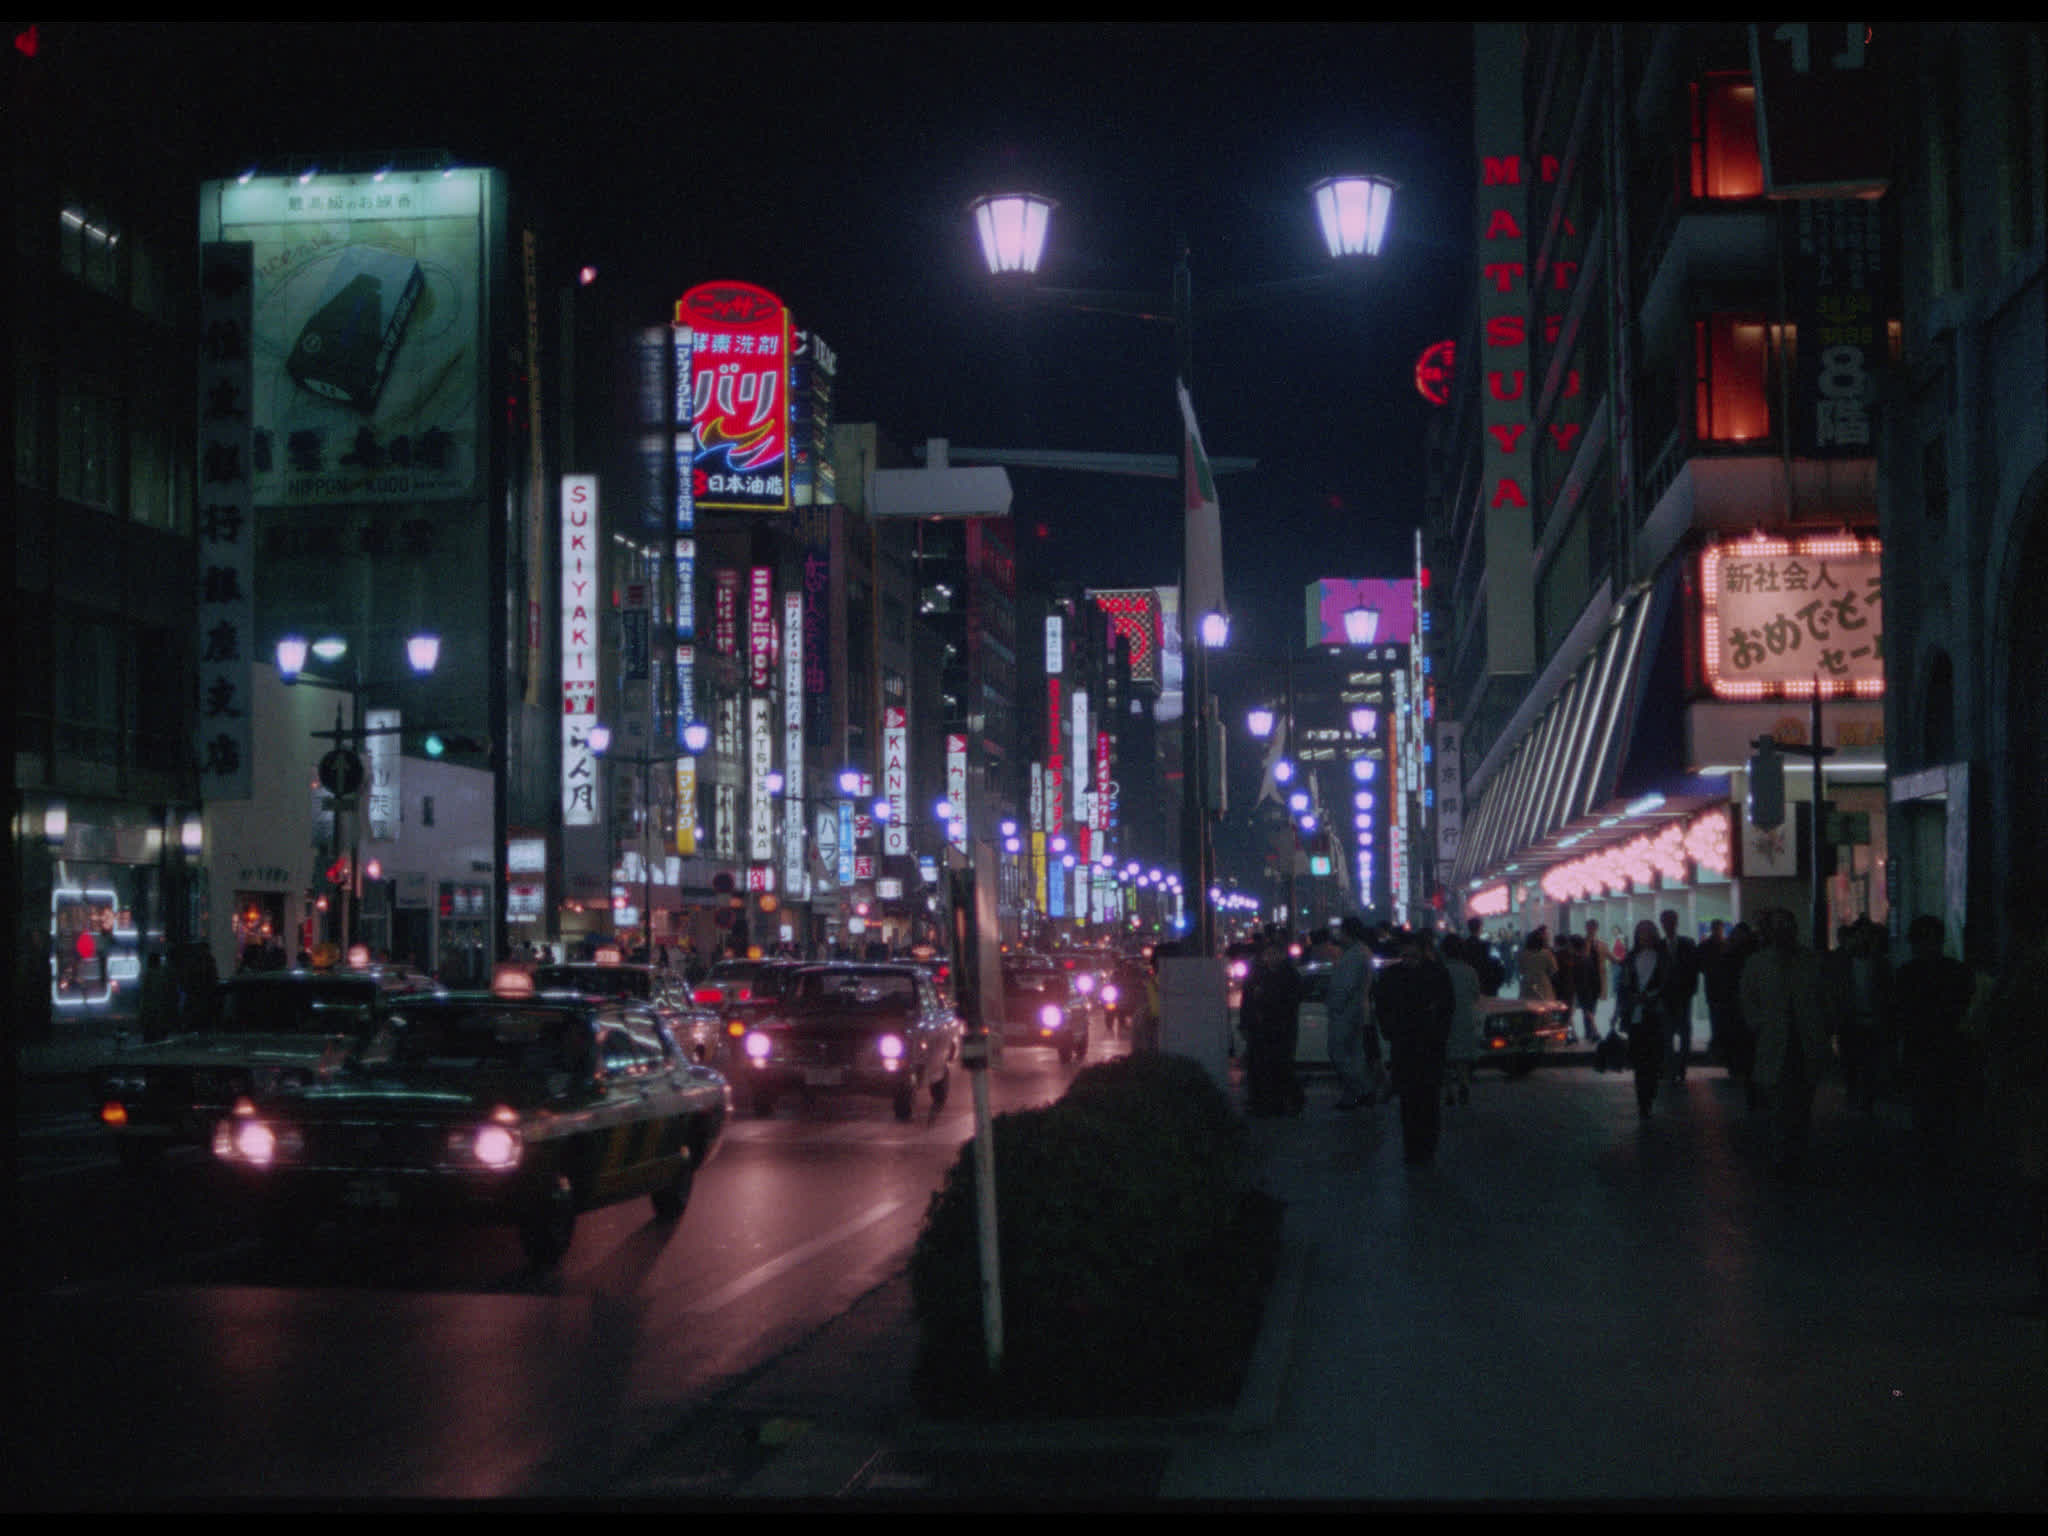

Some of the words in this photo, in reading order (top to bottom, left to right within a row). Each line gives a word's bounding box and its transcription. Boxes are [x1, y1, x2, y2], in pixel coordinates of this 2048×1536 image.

[694, 292, 771, 318] ニッサン
[1483, 155, 1527, 507] MATSUYA
[288, 478, 347, 496] NIPPON
[708, 474, 784, 496] 日本油脂
[571, 485, 588, 670] SUKIYAKI
[1726, 561, 1838, 593] 新社会人
[755, 711, 768, 849] MATSUSHIMA
[889, 736, 902, 848] KANEBO
